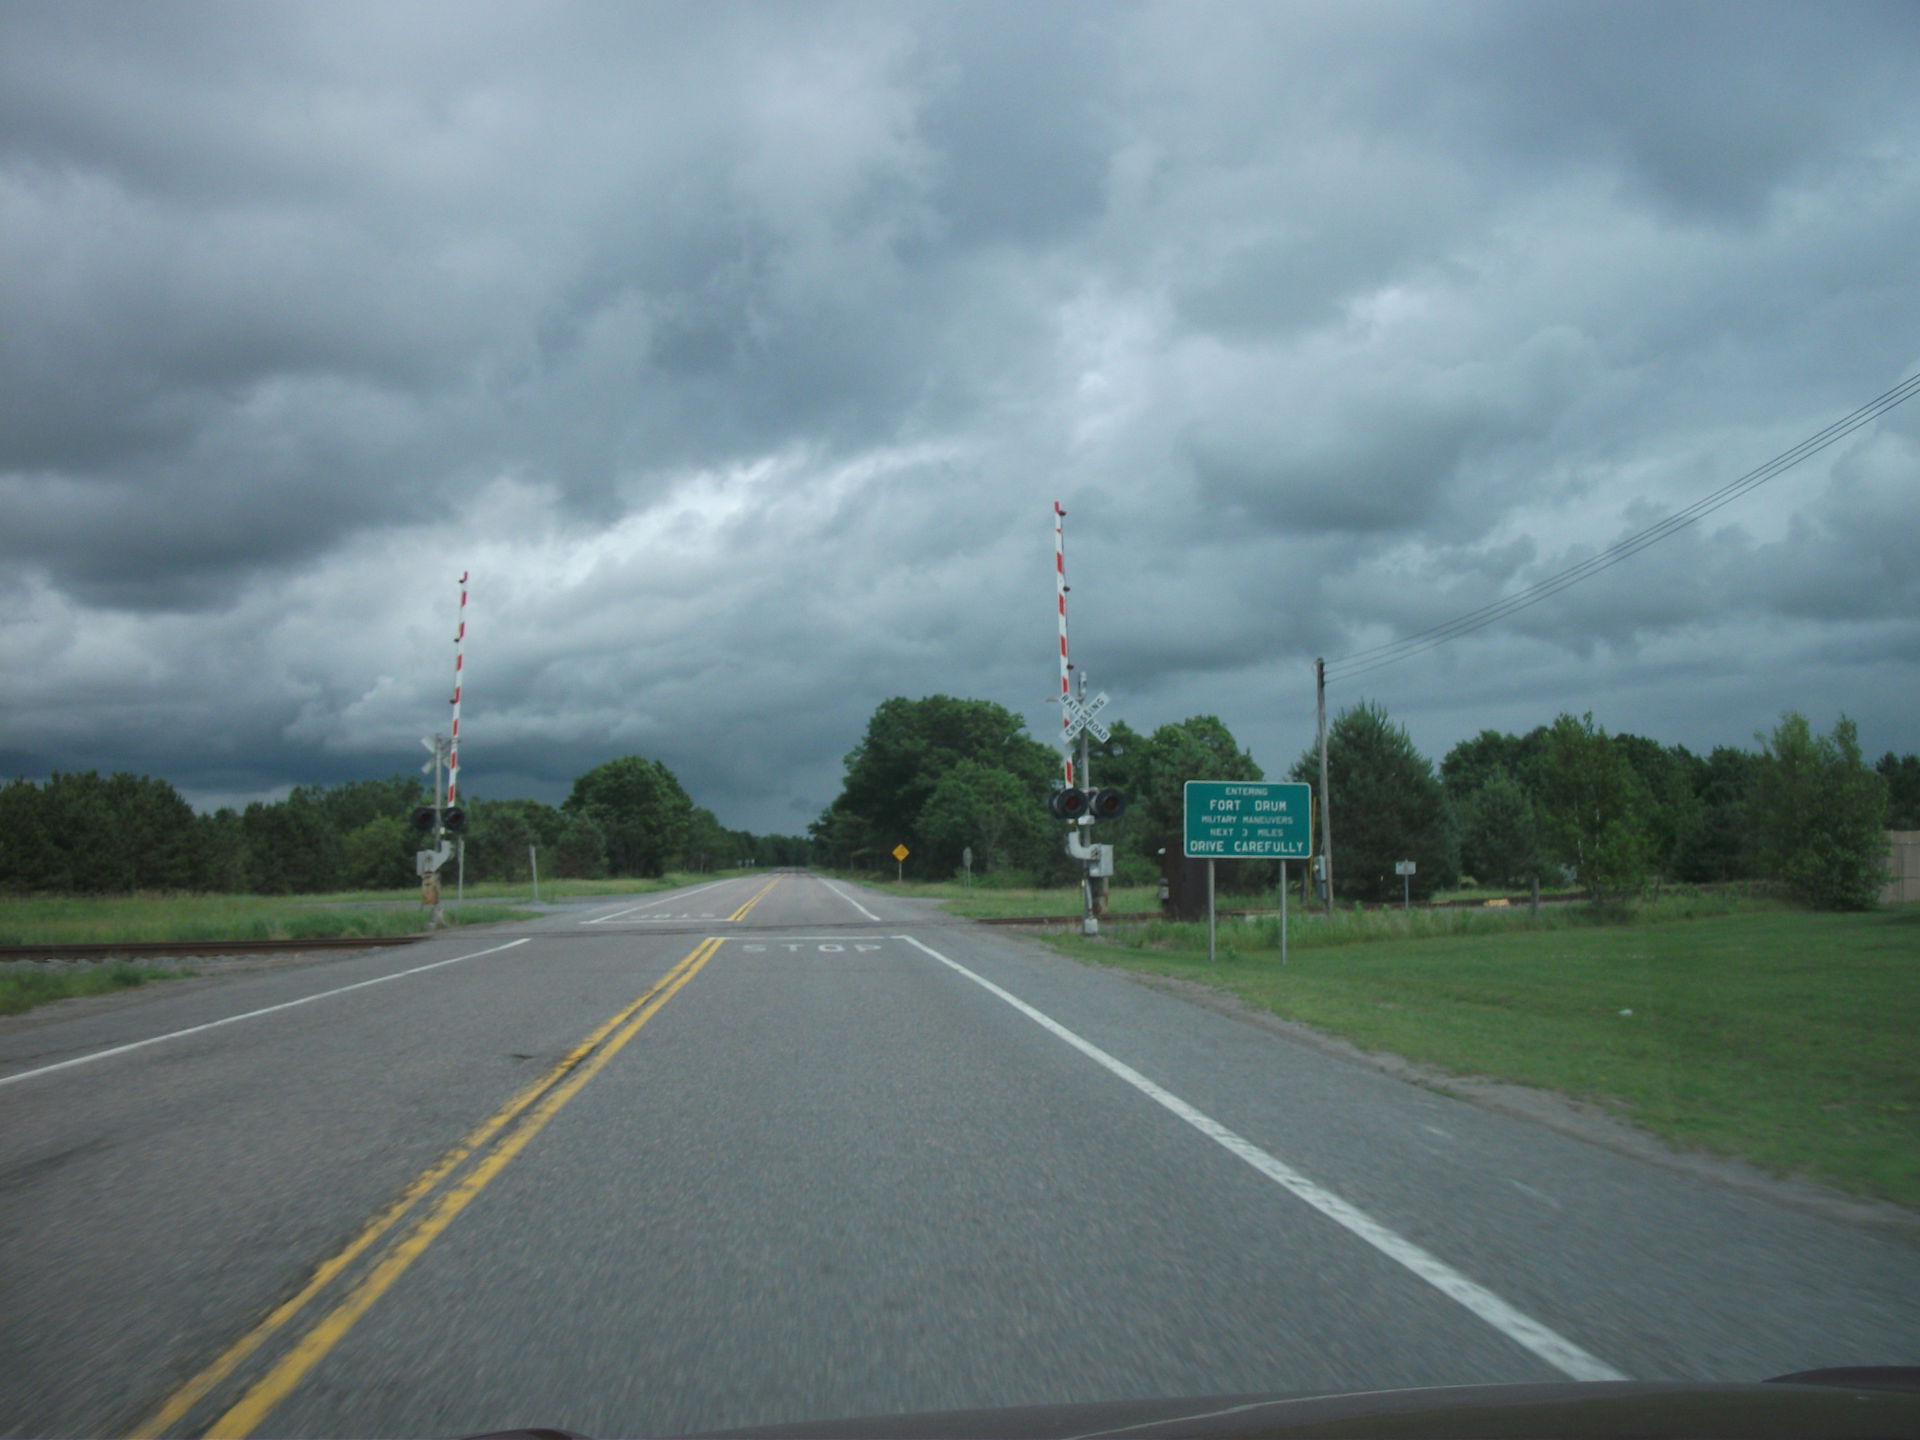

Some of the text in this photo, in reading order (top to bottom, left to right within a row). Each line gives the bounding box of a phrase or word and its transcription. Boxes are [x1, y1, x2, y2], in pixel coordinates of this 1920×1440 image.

[1061, 694, 1108, 740] RAIL ROAD
[1065, 697, 1105, 737] CROSSING
[1225, 787, 1268, 796] ENTERING
[1209, 799, 1287, 812] FORT DRUM
[1201, 815, 1237, 824] MILITARY
[1210, 828, 1233, 837] NEXT
[1257, 829, 1284, 838] MILES
[1190, 840, 1303, 853] DRIVE CAREFULLY
[742, 943, 882, 952] STOP
